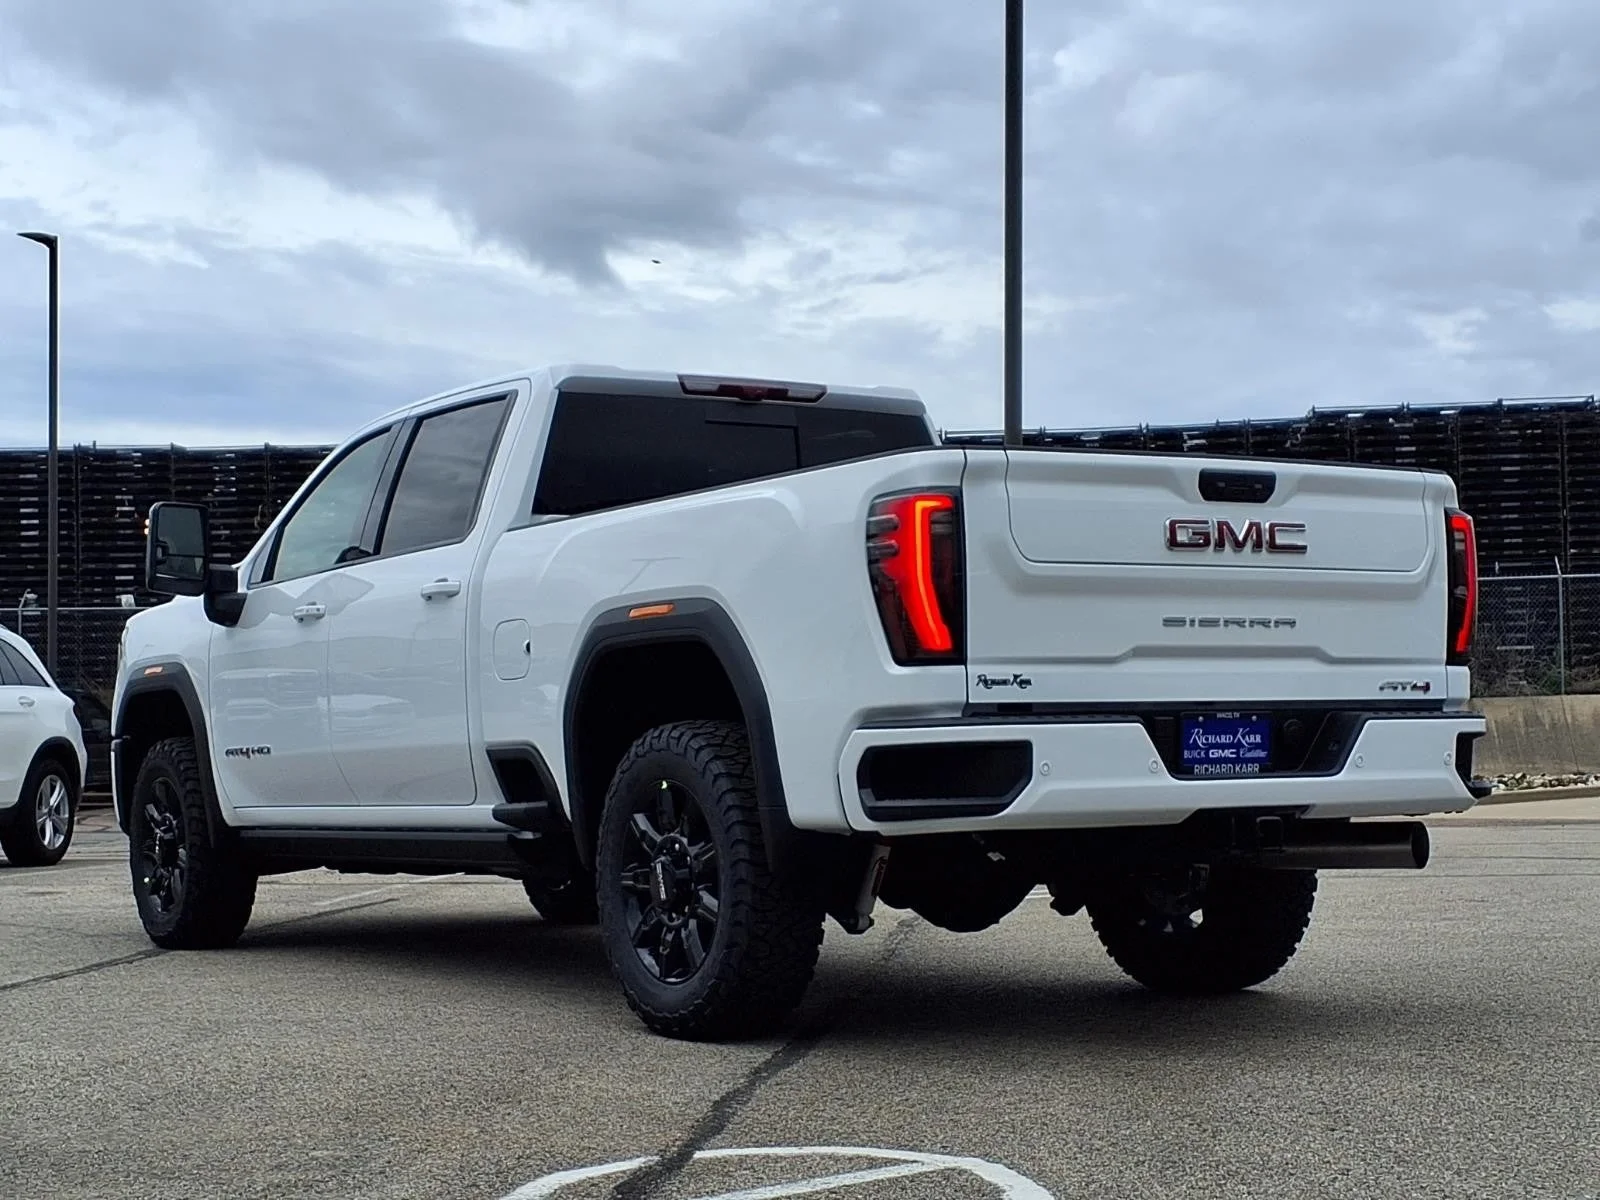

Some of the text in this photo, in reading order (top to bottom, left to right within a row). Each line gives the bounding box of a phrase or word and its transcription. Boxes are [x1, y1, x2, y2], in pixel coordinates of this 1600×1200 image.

[1164, 517, 1308, 553] GMC
[1162, 616, 1296, 628] SIERRA
[1379, 681, 1430, 694] AT4
[1184, 749, 1205, 759] BUICK
[1209, 749, 1237, 758] GMC
[1194, 763, 1260, 775] RICHARD KARR
